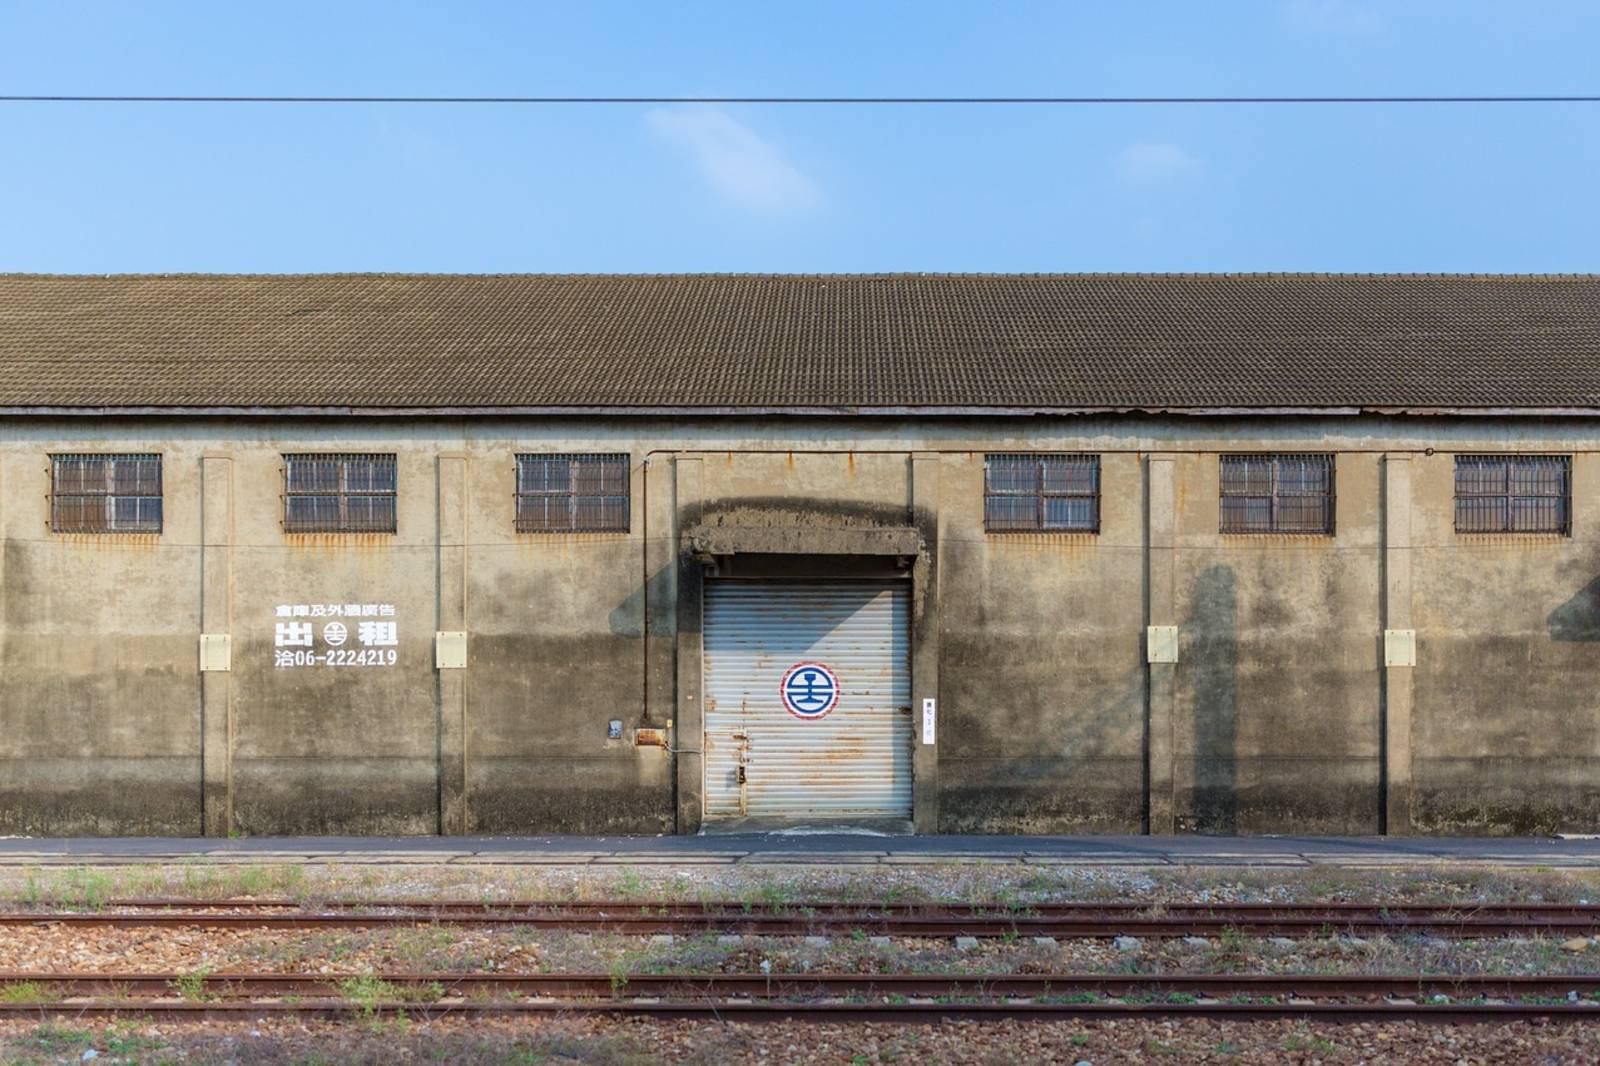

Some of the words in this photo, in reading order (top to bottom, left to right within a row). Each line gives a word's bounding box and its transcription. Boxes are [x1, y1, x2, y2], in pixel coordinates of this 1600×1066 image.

[275, 622, 313, 646] 出
[358, 621, 398, 646] 租
[275, 650, 397, 667] 洽06-2224219
